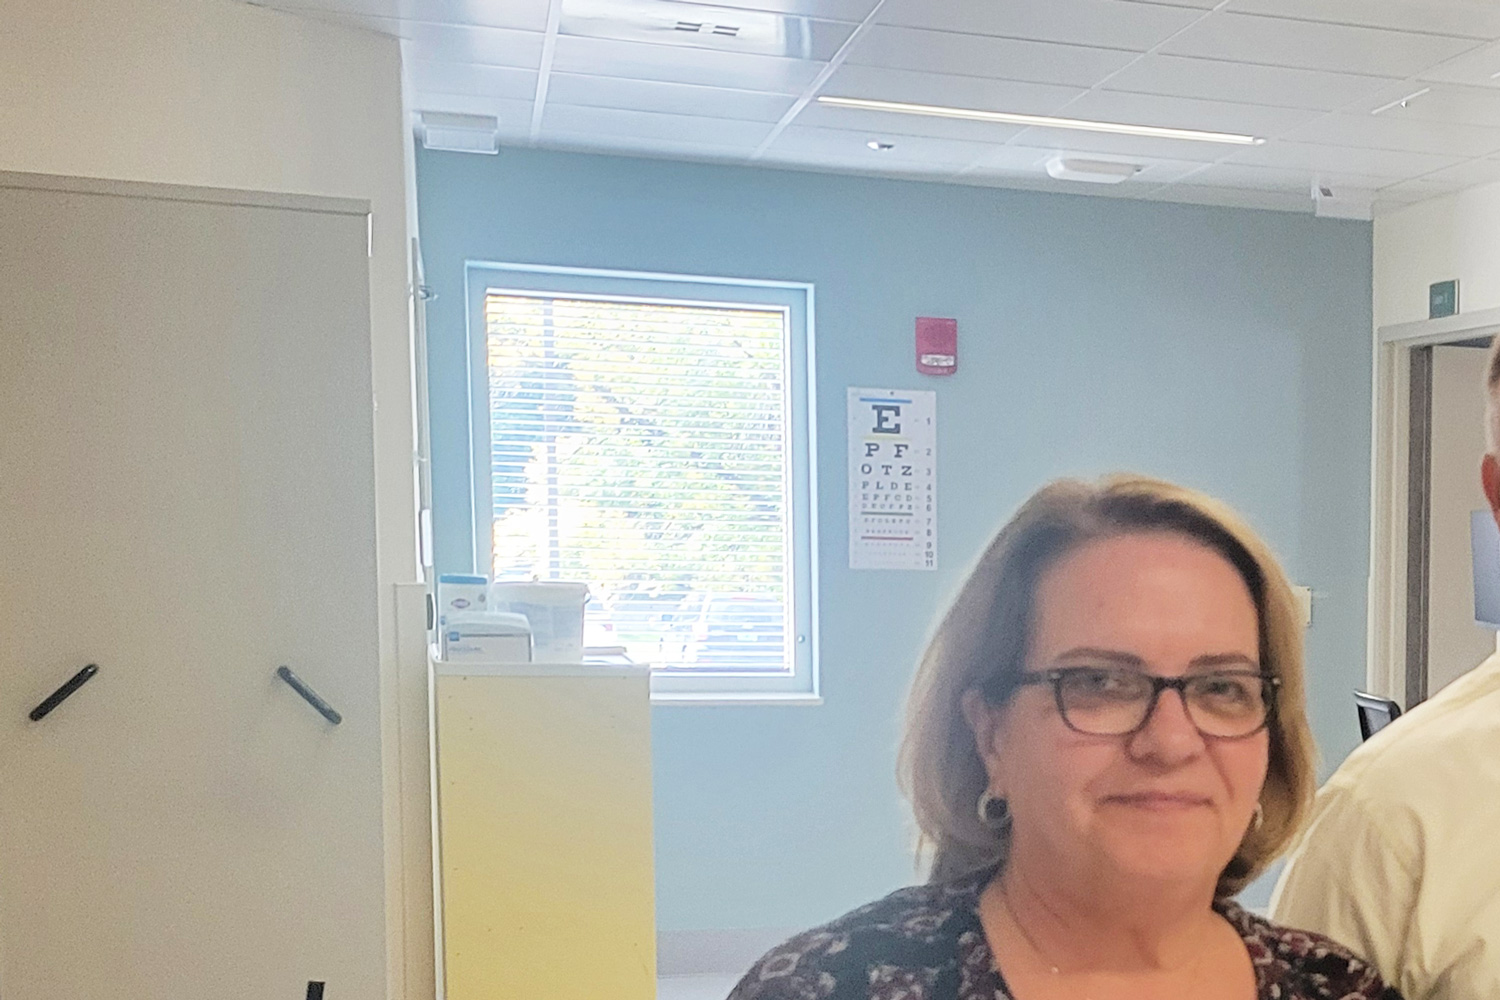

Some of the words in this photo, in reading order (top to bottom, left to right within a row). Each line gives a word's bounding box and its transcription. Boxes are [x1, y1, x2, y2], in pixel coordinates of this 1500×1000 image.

[872, 405, 900, 434] E
[865, 443, 880, 457] P
[894, 444, 909, 458] F
[861, 463, 872, 475] O
[881, 464, 892, 475] T
[901, 465, 912, 476] Z
[862, 481, 869, 489] P
[876, 481, 884, 490] L
[890, 482, 898, 490] D
[904, 482, 912, 491] E
